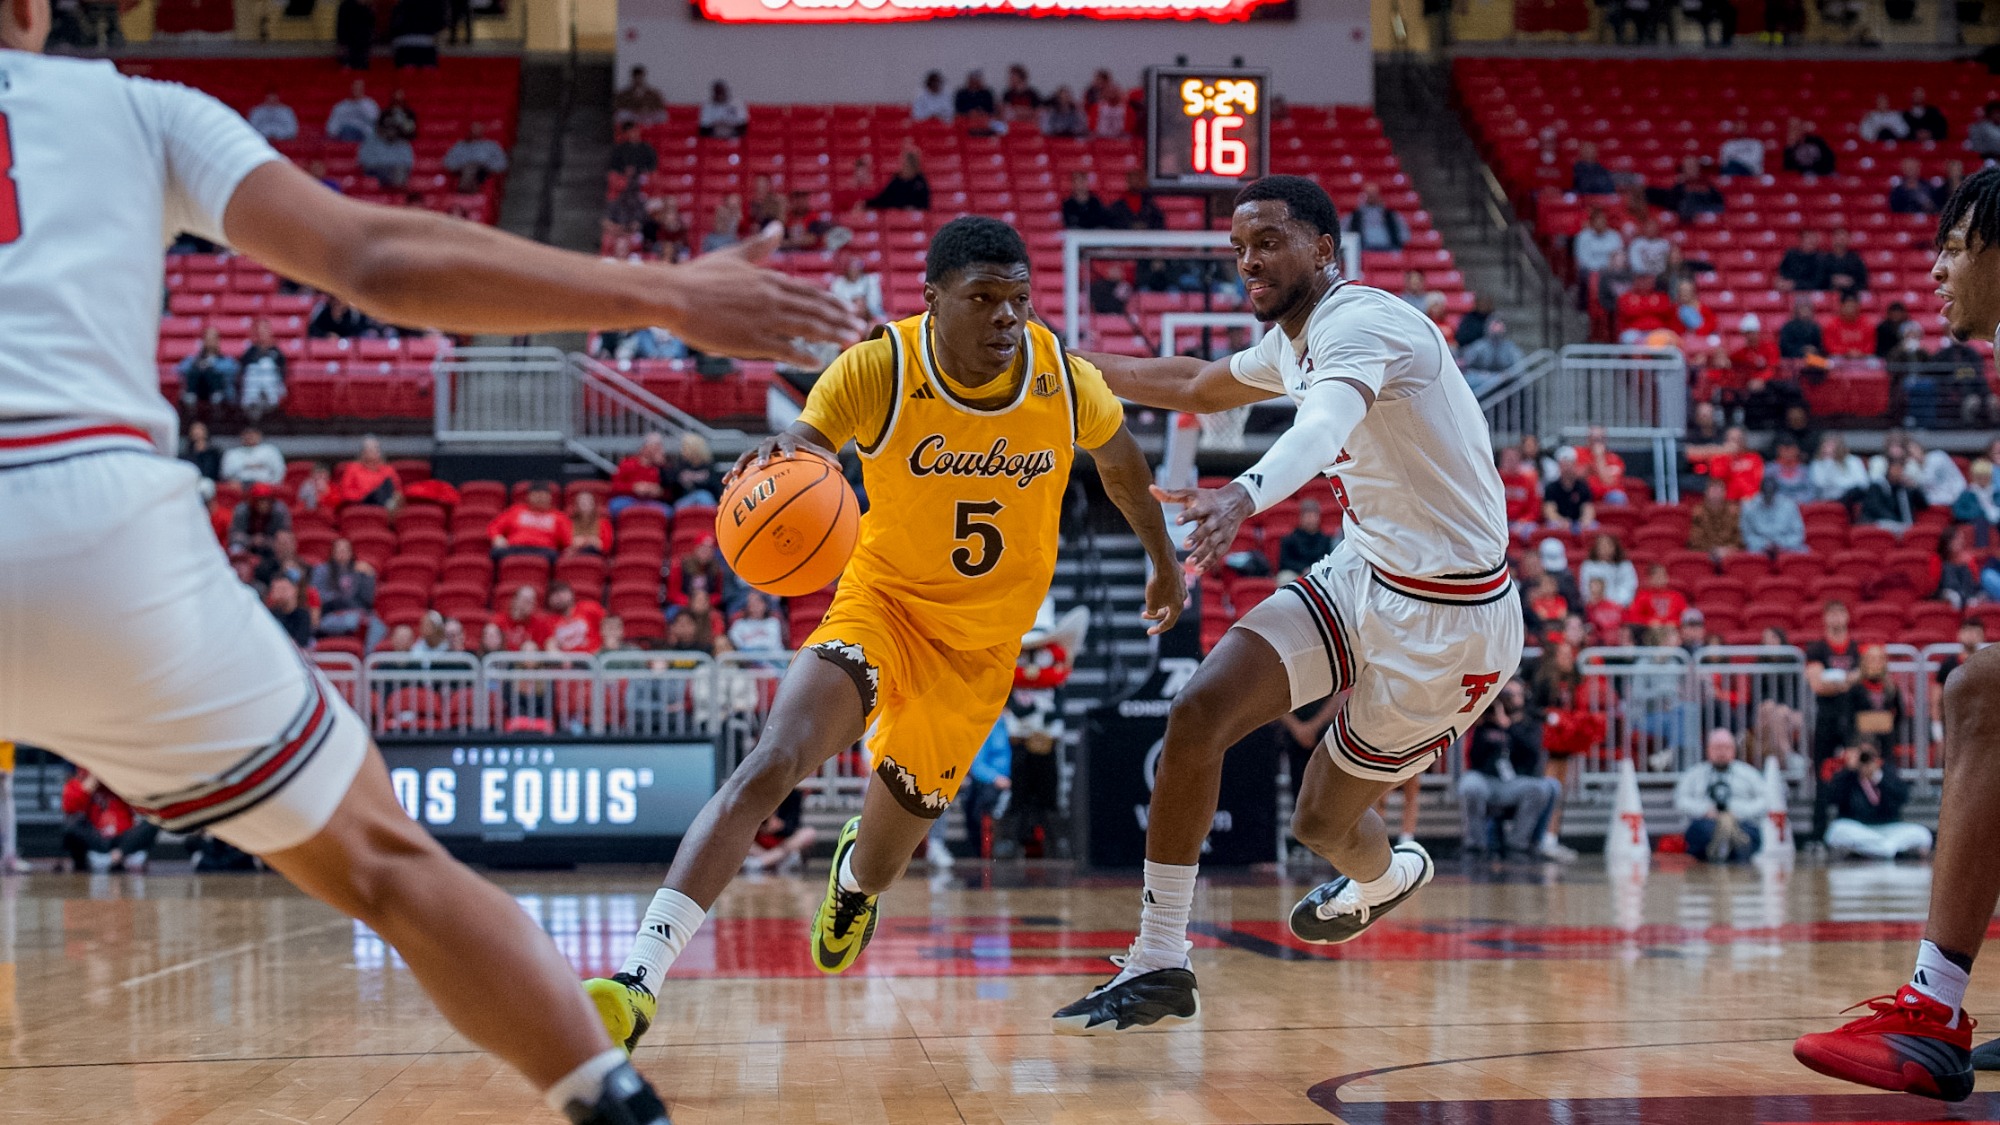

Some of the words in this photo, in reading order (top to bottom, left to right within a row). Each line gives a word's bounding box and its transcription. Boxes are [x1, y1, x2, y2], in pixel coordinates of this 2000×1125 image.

[1180, 78, 1258, 116] 5:29
[1192, 115, 1248, 177] 16
[907, 433, 1055, 489] Cowboys
[733, 477, 776, 527] EVO
[950, 497, 1007, 578] 5
